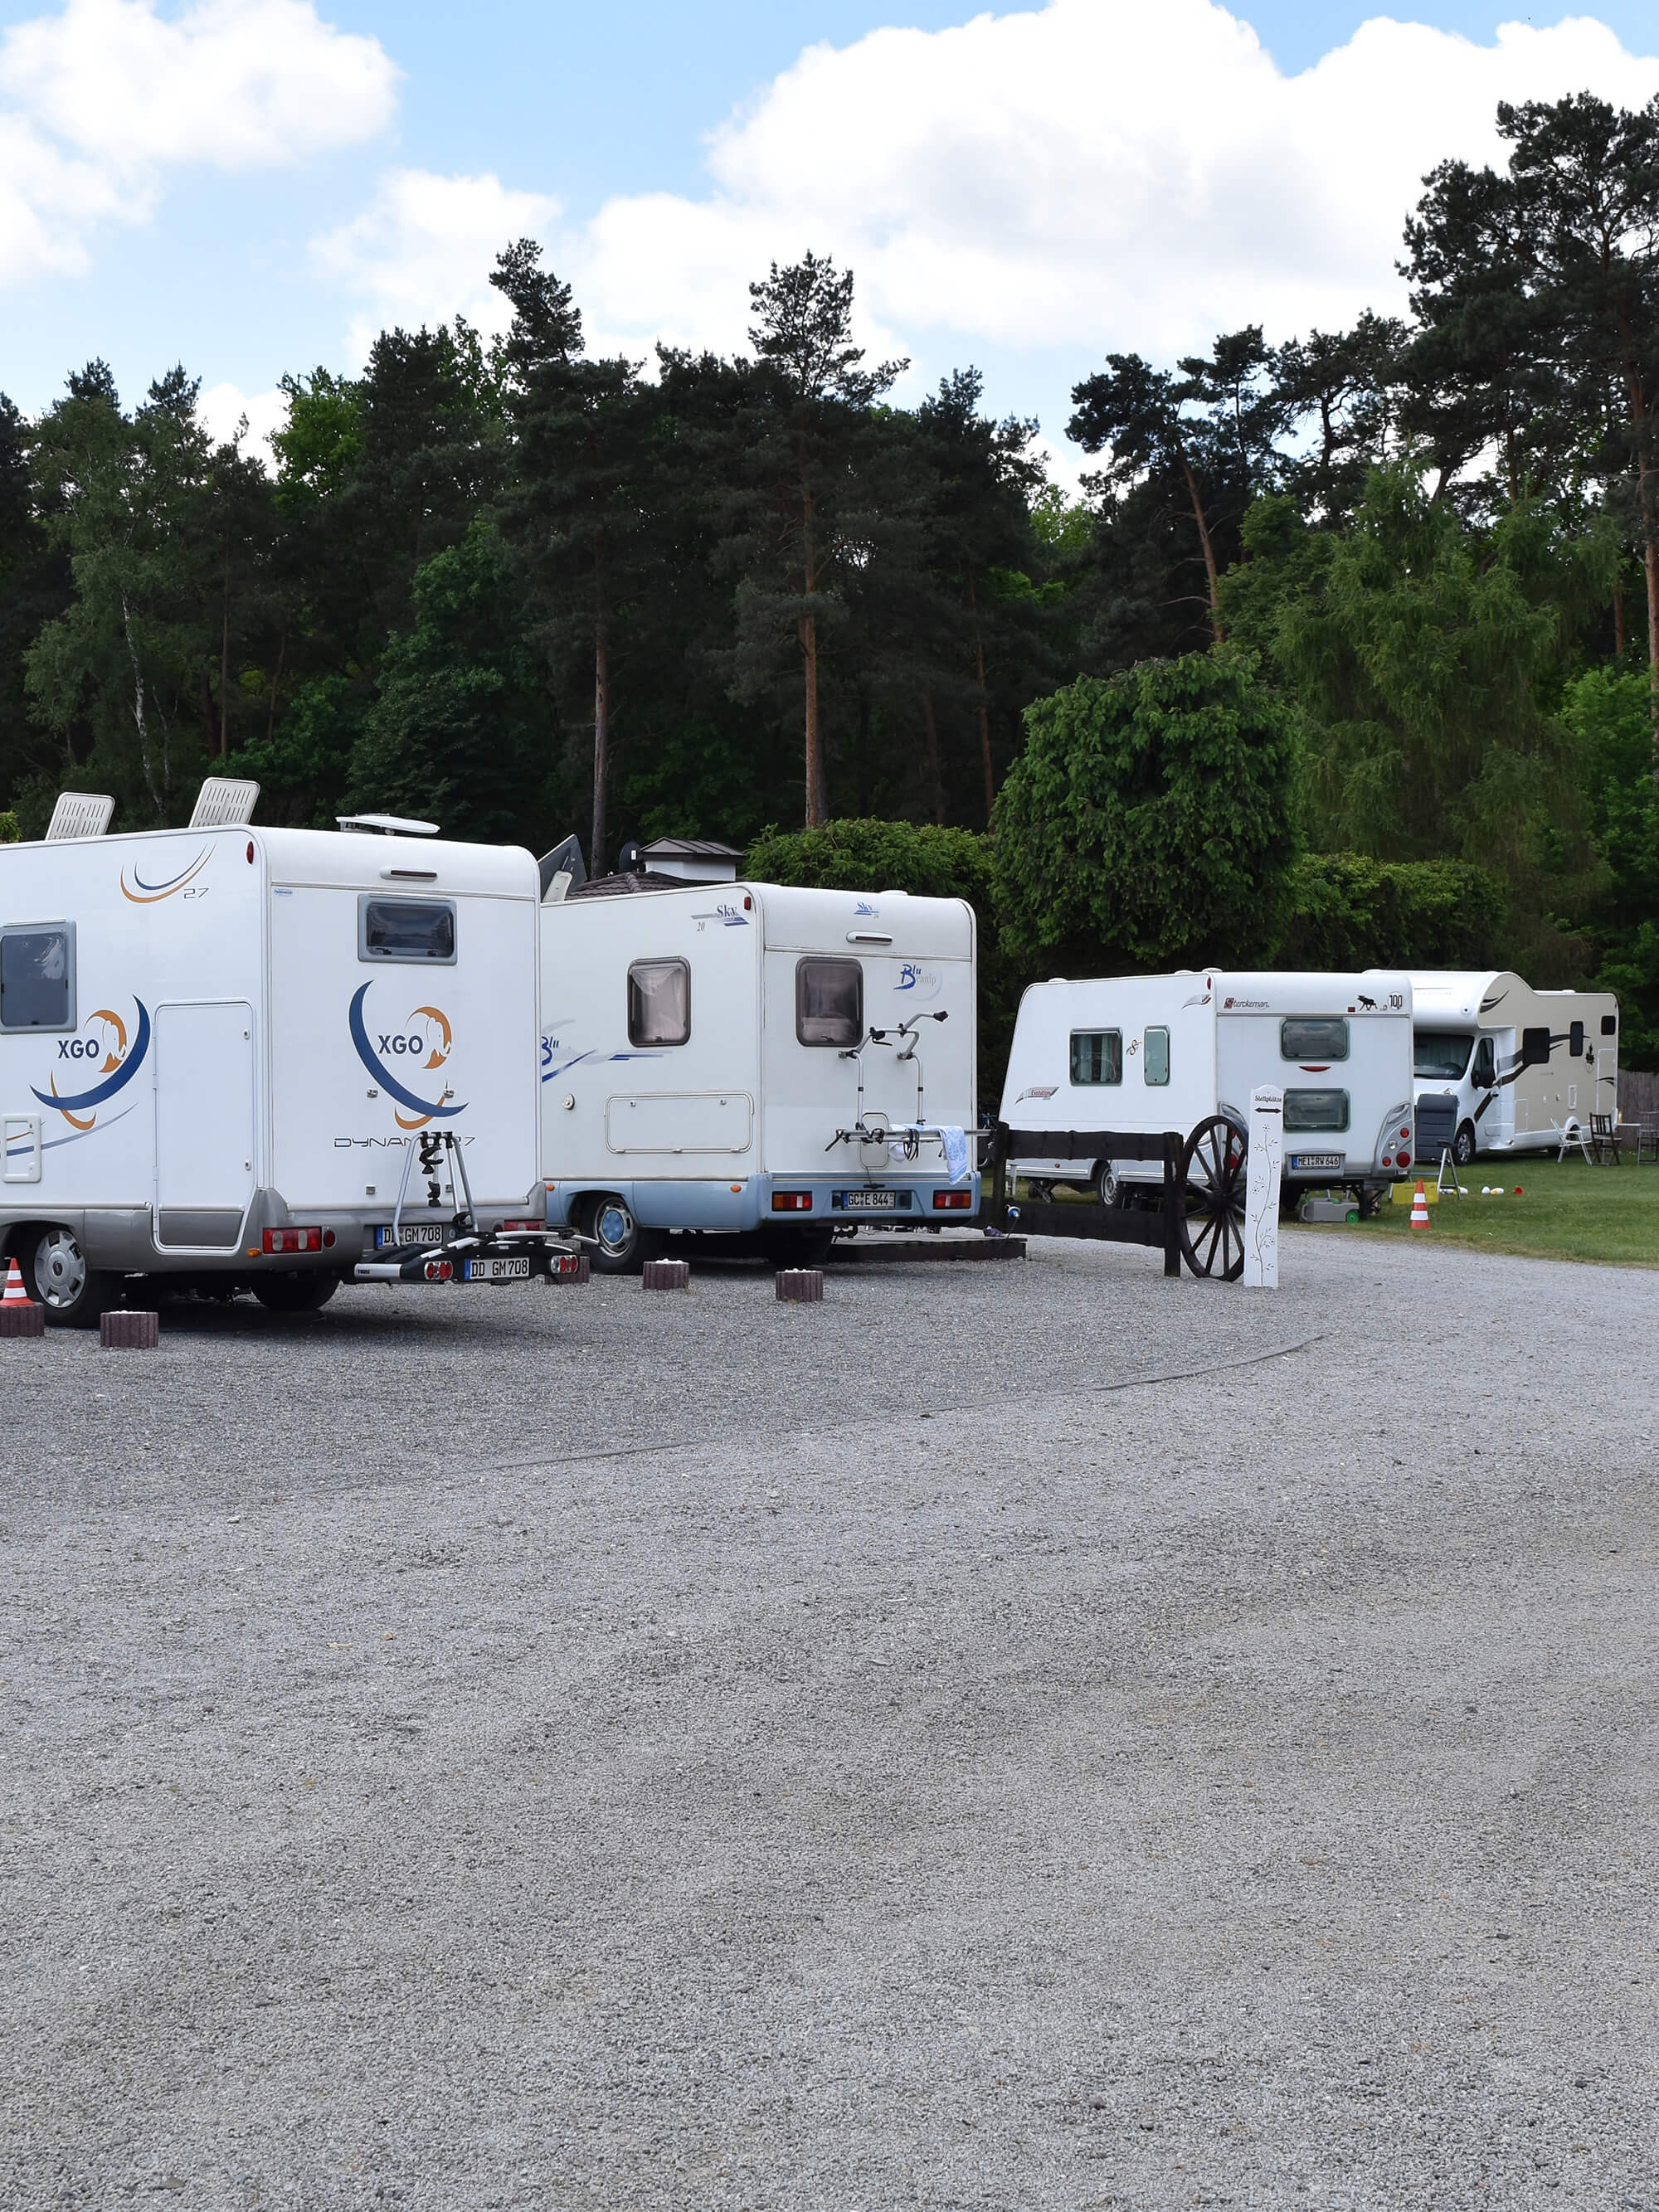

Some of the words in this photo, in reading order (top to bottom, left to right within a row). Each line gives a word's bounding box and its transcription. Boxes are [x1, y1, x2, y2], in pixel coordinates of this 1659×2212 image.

[183, 888, 209, 899] 27
[717, 904, 737, 918] Sky
[697, 921, 705, 931] 20
[893, 964, 922, 989] Blu
[1389, 994, 1403, 1008] 100
[57, 1039, 100, 1059] XGO
[378, 1035, 423, 1055] XGO
[1297, 1156, 1311, 1166] MEI
[1315, 1156, 1325, 1165] RW
[1326, 1156, 1339, 1165] 646
[849, 1194, 860, 1206] GC
[865, 1194, 871, 1206] E
[873, 1194, 888, 1206] 844
[405, 1228, 419, 1242] GM
[421, 1227, 441, 1242] 708
[471, 1262, 485, 1277] DD
[492, 1261, 506, 1276] GM
[508, 1259, 528, 1275] 708
